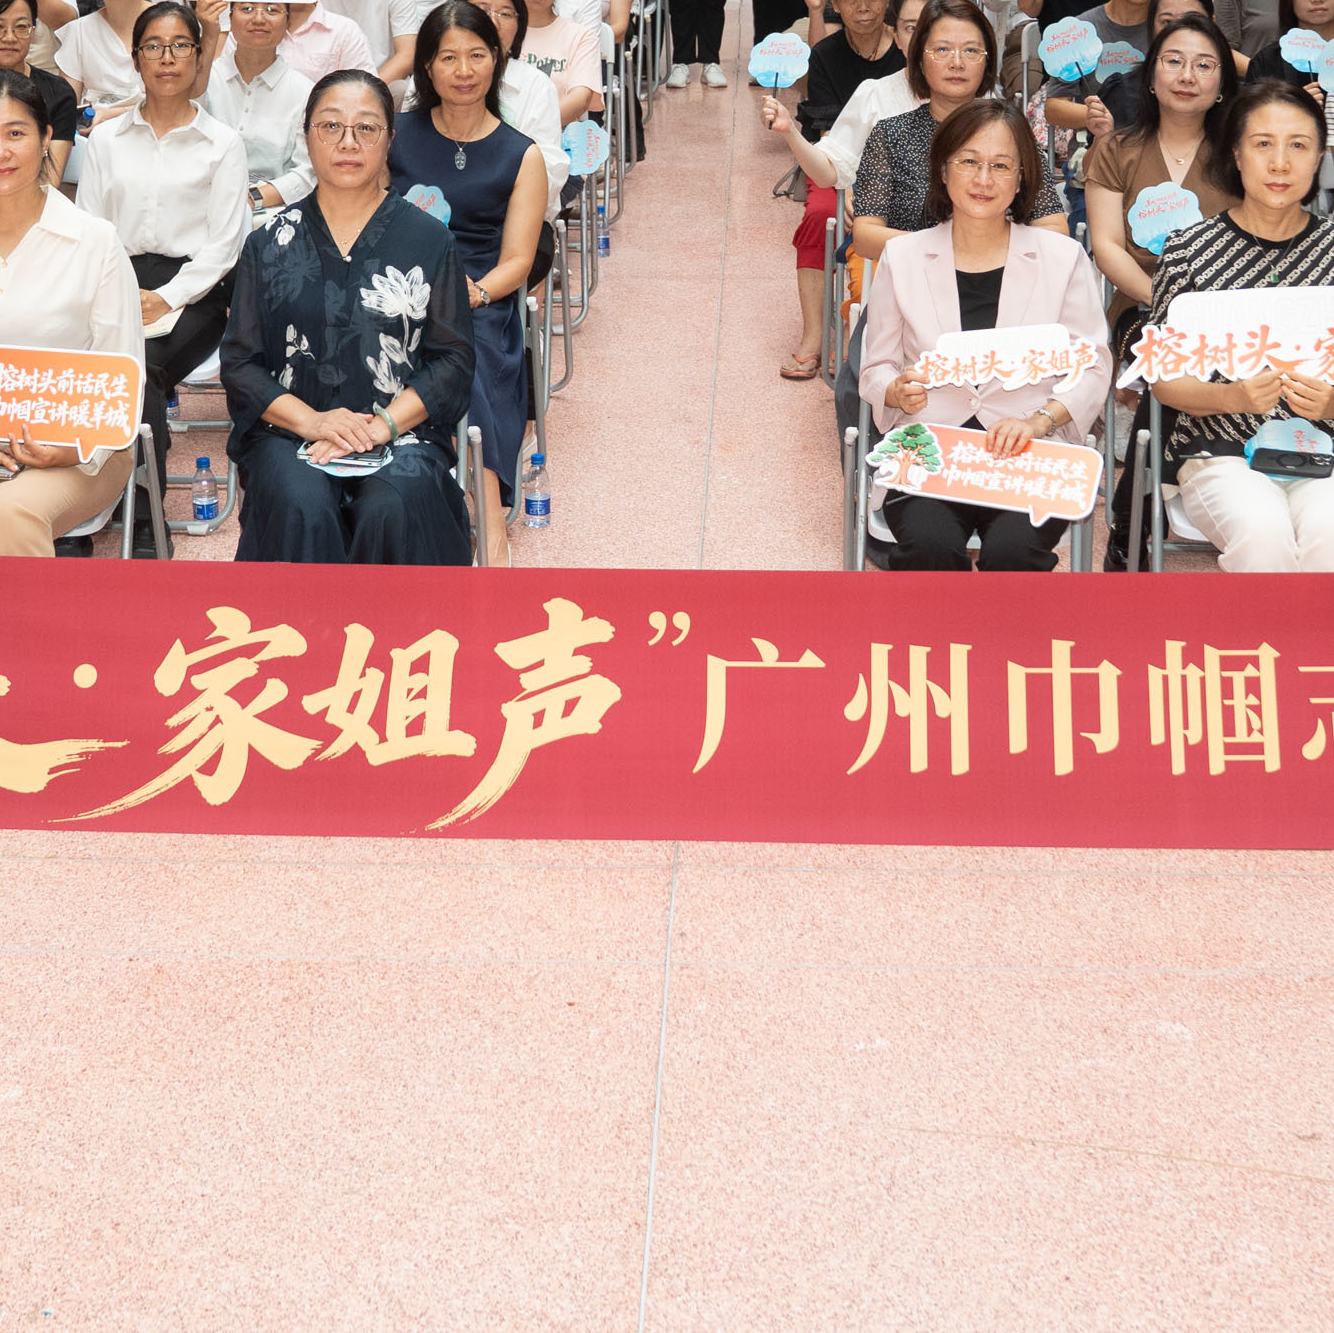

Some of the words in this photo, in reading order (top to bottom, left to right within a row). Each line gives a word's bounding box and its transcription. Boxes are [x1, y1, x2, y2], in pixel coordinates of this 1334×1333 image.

[920, 342, 1094, 387] 榕树头·家姐声
[942, 464, 1087, 510] 巾帼宣讲暖羊城
